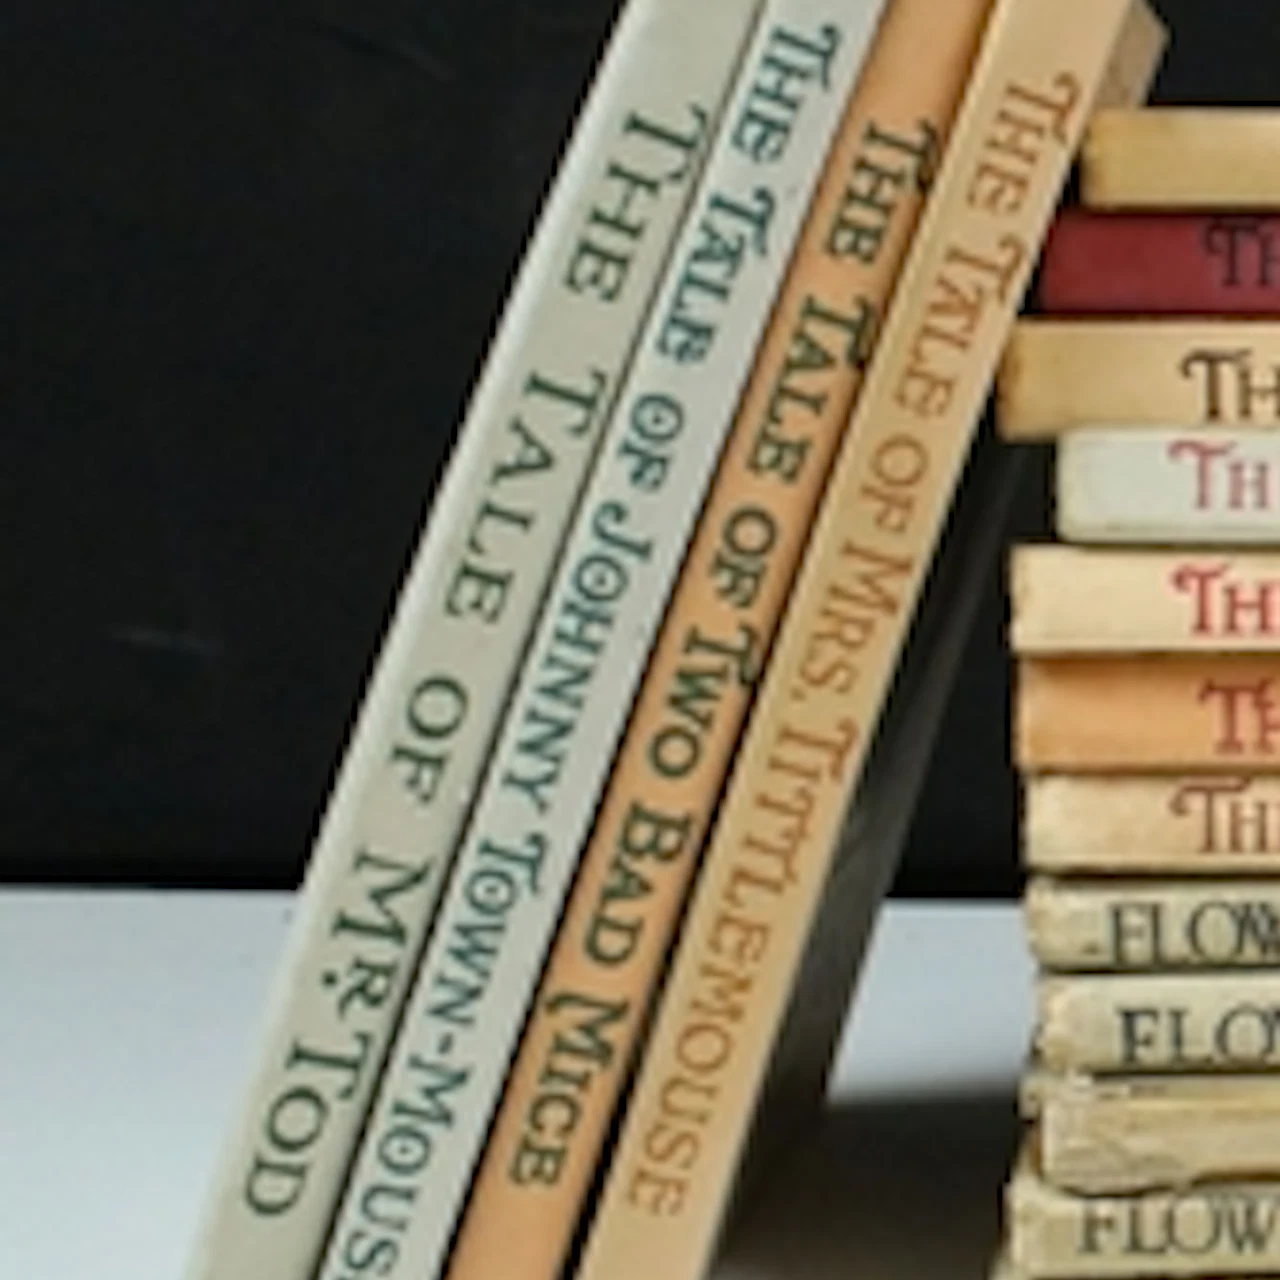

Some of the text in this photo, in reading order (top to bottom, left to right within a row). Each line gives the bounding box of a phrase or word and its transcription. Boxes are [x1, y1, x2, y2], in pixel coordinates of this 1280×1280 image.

[732, 23, 842, 164] THE
[565, 103, 708, 304] THE
[655, 187, 777, 365] TALE
[446, 370, 607, 625] TALE
[616, 393, 685, 492] OF
[388, 675, 469, 803] OF
[501, 501, 653, 814] JOHNNY
[511, 119, 941, 1189] THE TALE OF TWO BAD MICE
[627, 71, 1080, 1218] THE TALE OF MRS. TITTLEMOUSE
[245, 1032, 370, 1217] TOD
